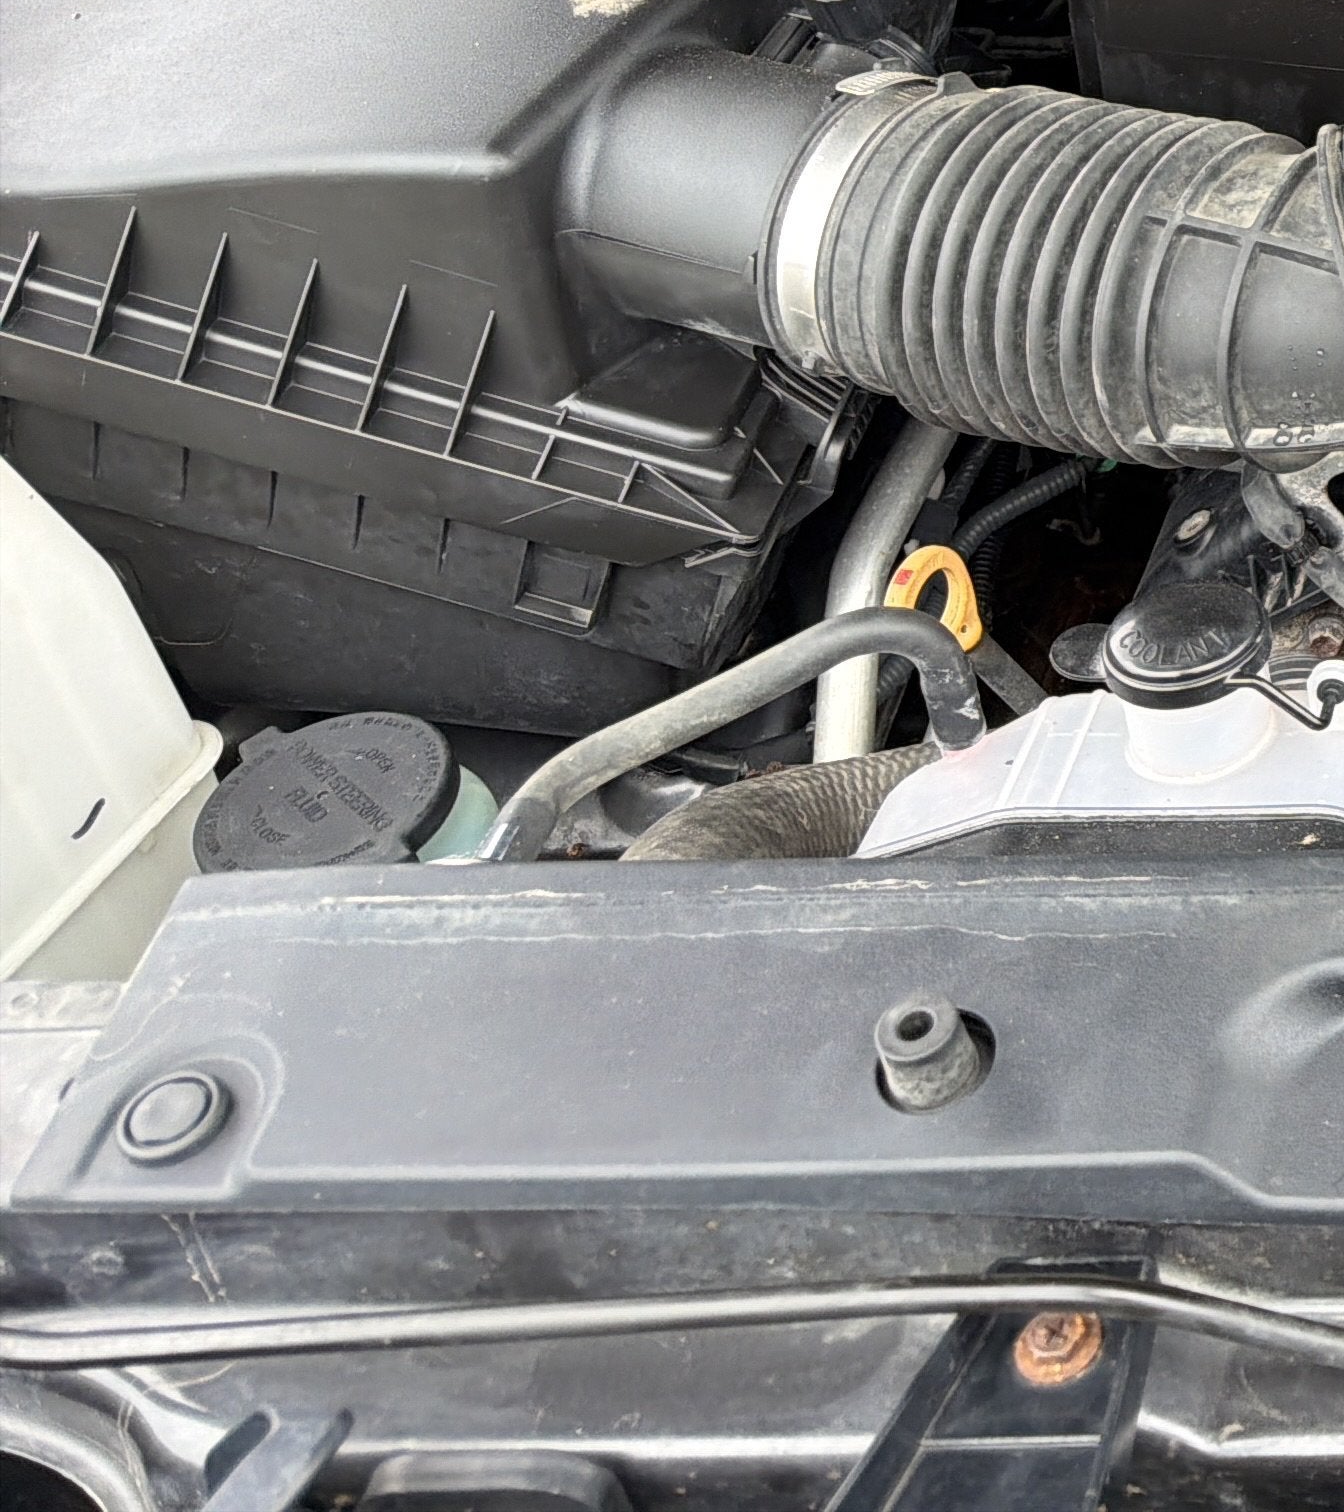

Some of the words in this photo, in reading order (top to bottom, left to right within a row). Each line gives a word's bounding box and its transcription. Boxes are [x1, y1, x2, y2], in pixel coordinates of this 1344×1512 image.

[1118, 625, 1233, 666] COOLANT
[364, 748, 396, 774] OPEN
[284, 784, 329, 824] FLUID
[286, 737, 338, 784] POWER
[328, 774, 395, 833] STEERING
